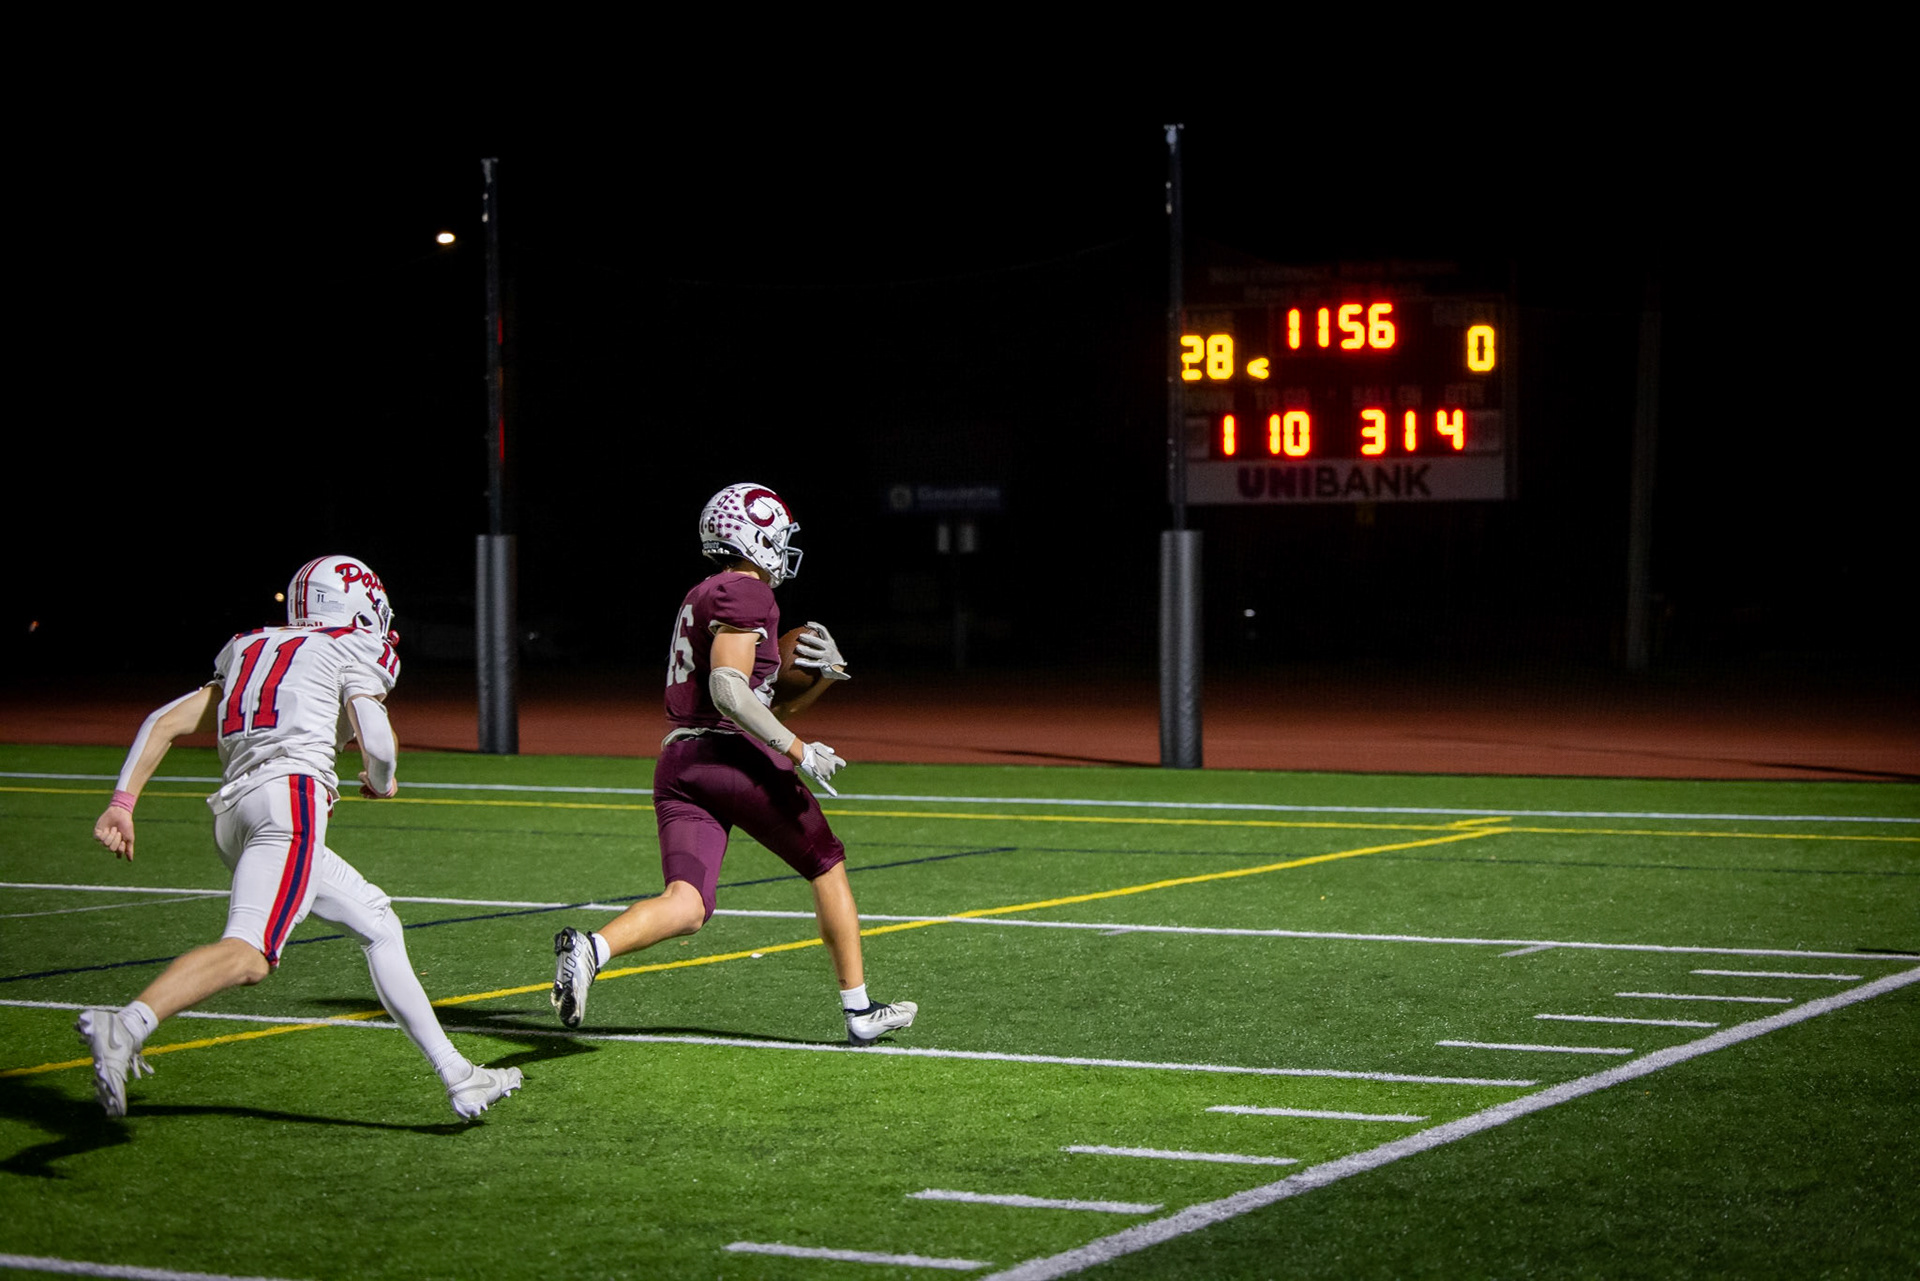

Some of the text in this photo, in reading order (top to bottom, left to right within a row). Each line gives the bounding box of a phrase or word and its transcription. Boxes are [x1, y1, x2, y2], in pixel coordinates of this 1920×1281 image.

[1180, 334, 1235, 381] 28
[1467, 324, 1496, 372] 0
[1222, 414, 1236, 456] 1
[1267, 409, 1312, 457] 10
[1237, 464, 1431, 498] UNIBANK
[377, 642, 400, 678] 11
[222, 636, 308, 738] 11
